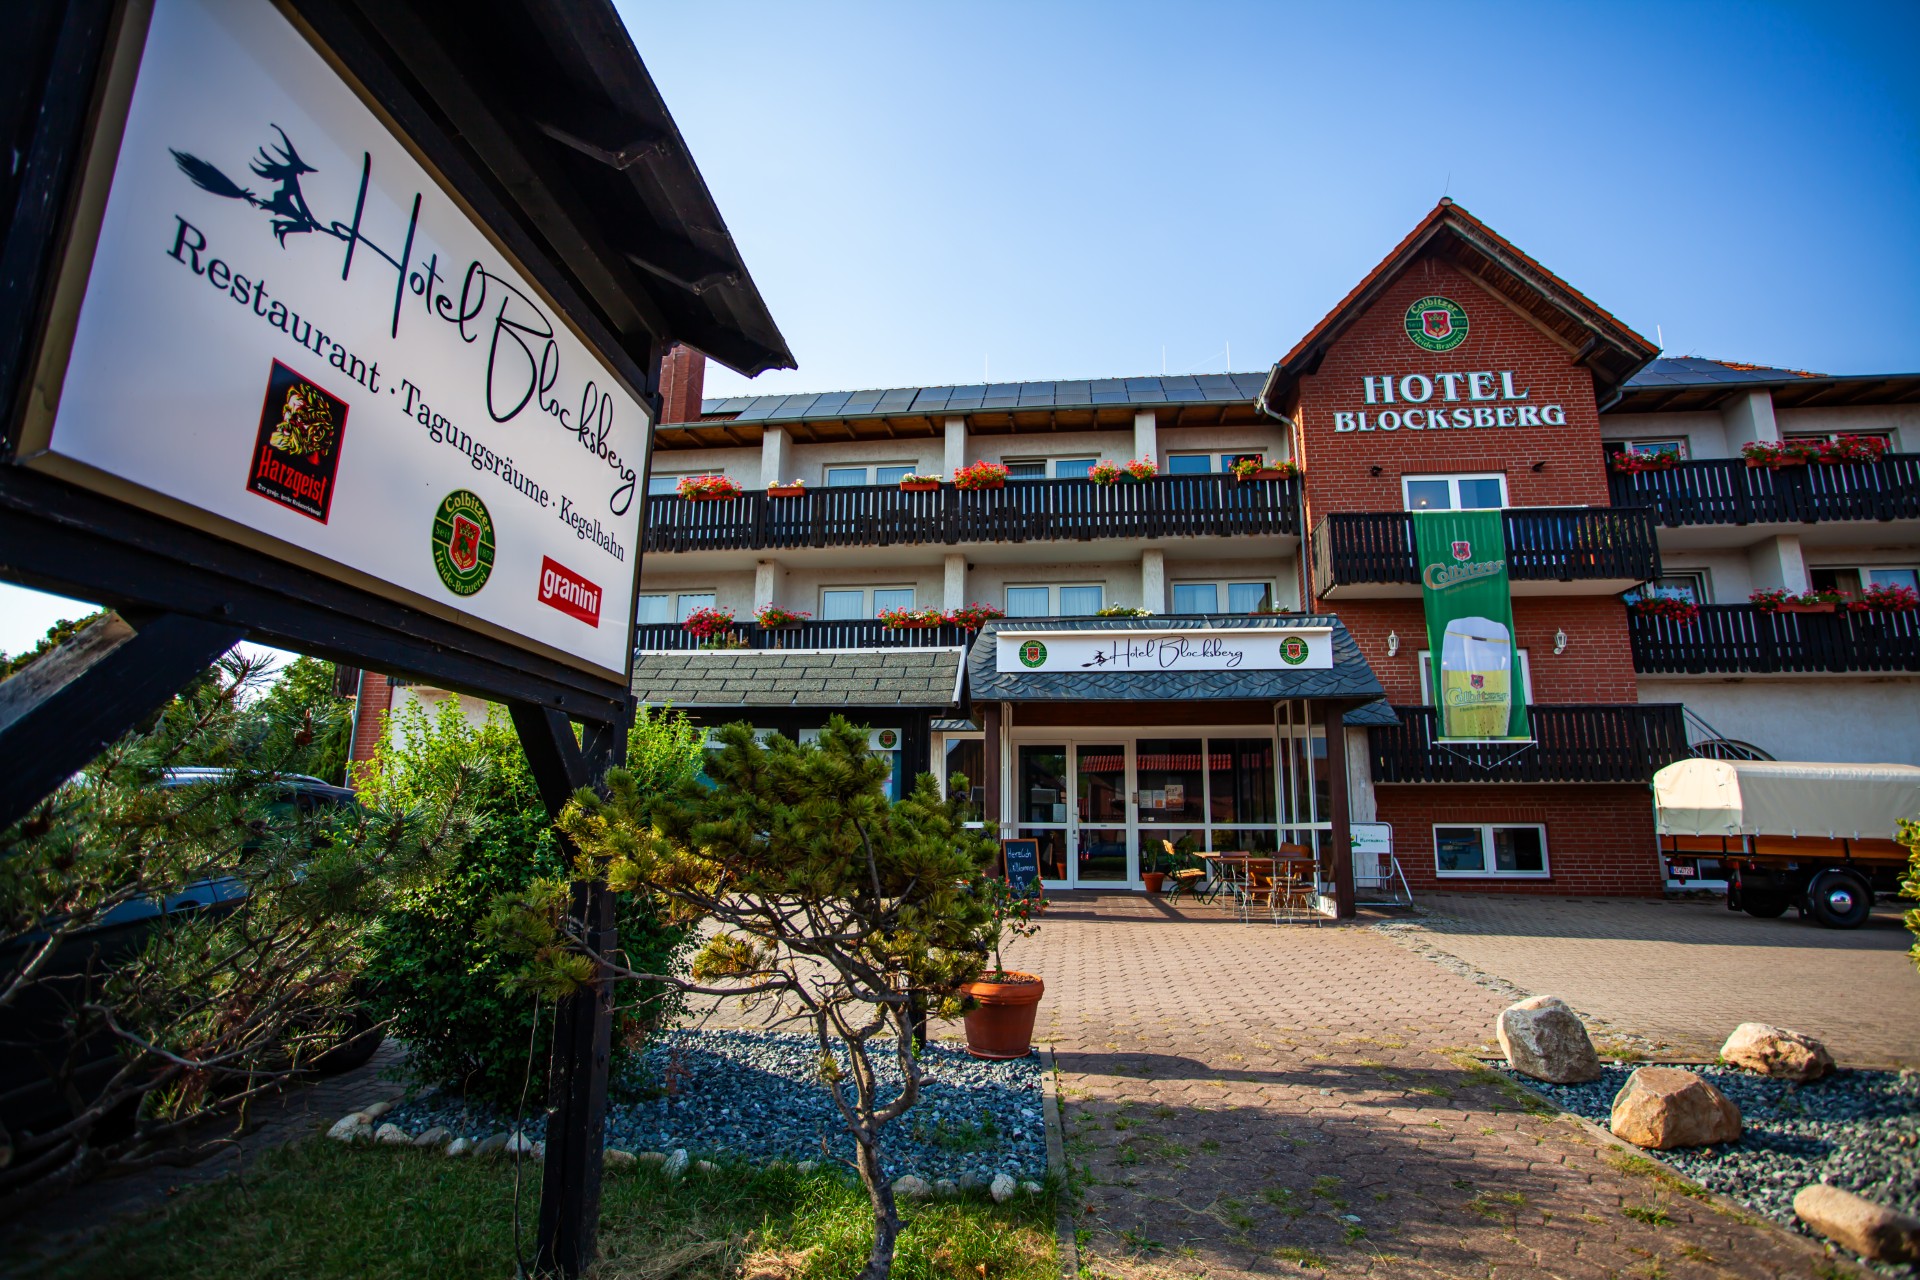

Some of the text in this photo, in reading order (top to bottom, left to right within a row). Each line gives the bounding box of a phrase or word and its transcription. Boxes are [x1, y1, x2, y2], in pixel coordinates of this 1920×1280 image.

[1411, 298, 1459, 314] Colbitzer
[330, 151, 637, 517] Hotel Blocksberg
[166, 214, 625, 563] Restaurant Tagungsräume Kegelbahn
[1361, 370, 1530, 405] HOTEL
[1333, 404, 1567, 433] BLOCKSBERG
[445, 492, 491, 533] Colbitzer
[435, 524, 451, 540] Seit
[435, 550, 487, 594] Heide-Brauerei
[1423, 560, 1505, 590] Colbitzer
[542, 568, 598, 614] granini
[1109, 636, 1243, 668] Hotel Blocksberg
